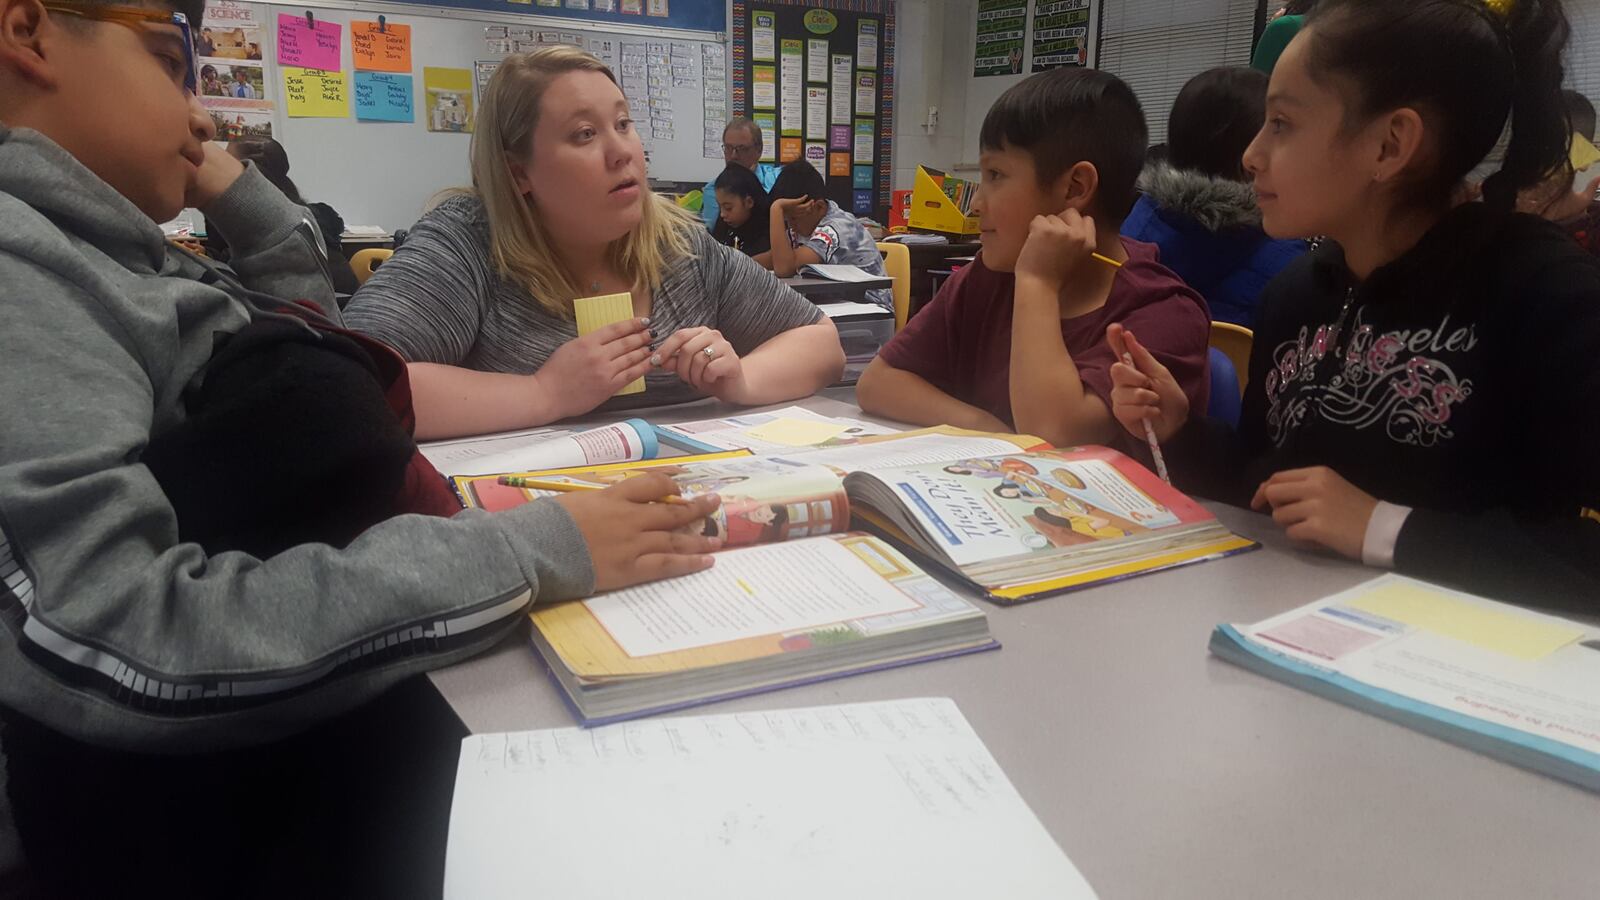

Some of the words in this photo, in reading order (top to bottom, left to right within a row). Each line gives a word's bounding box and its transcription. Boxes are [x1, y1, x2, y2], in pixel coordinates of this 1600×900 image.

[210, 9, 251, 20] SCIENCE
[937, 478, 968, 493] It!
[945, 503, 985, 540] They
[963, 496, 1011, 538] Mean
[1453, 695, 1520, 719] Reading
